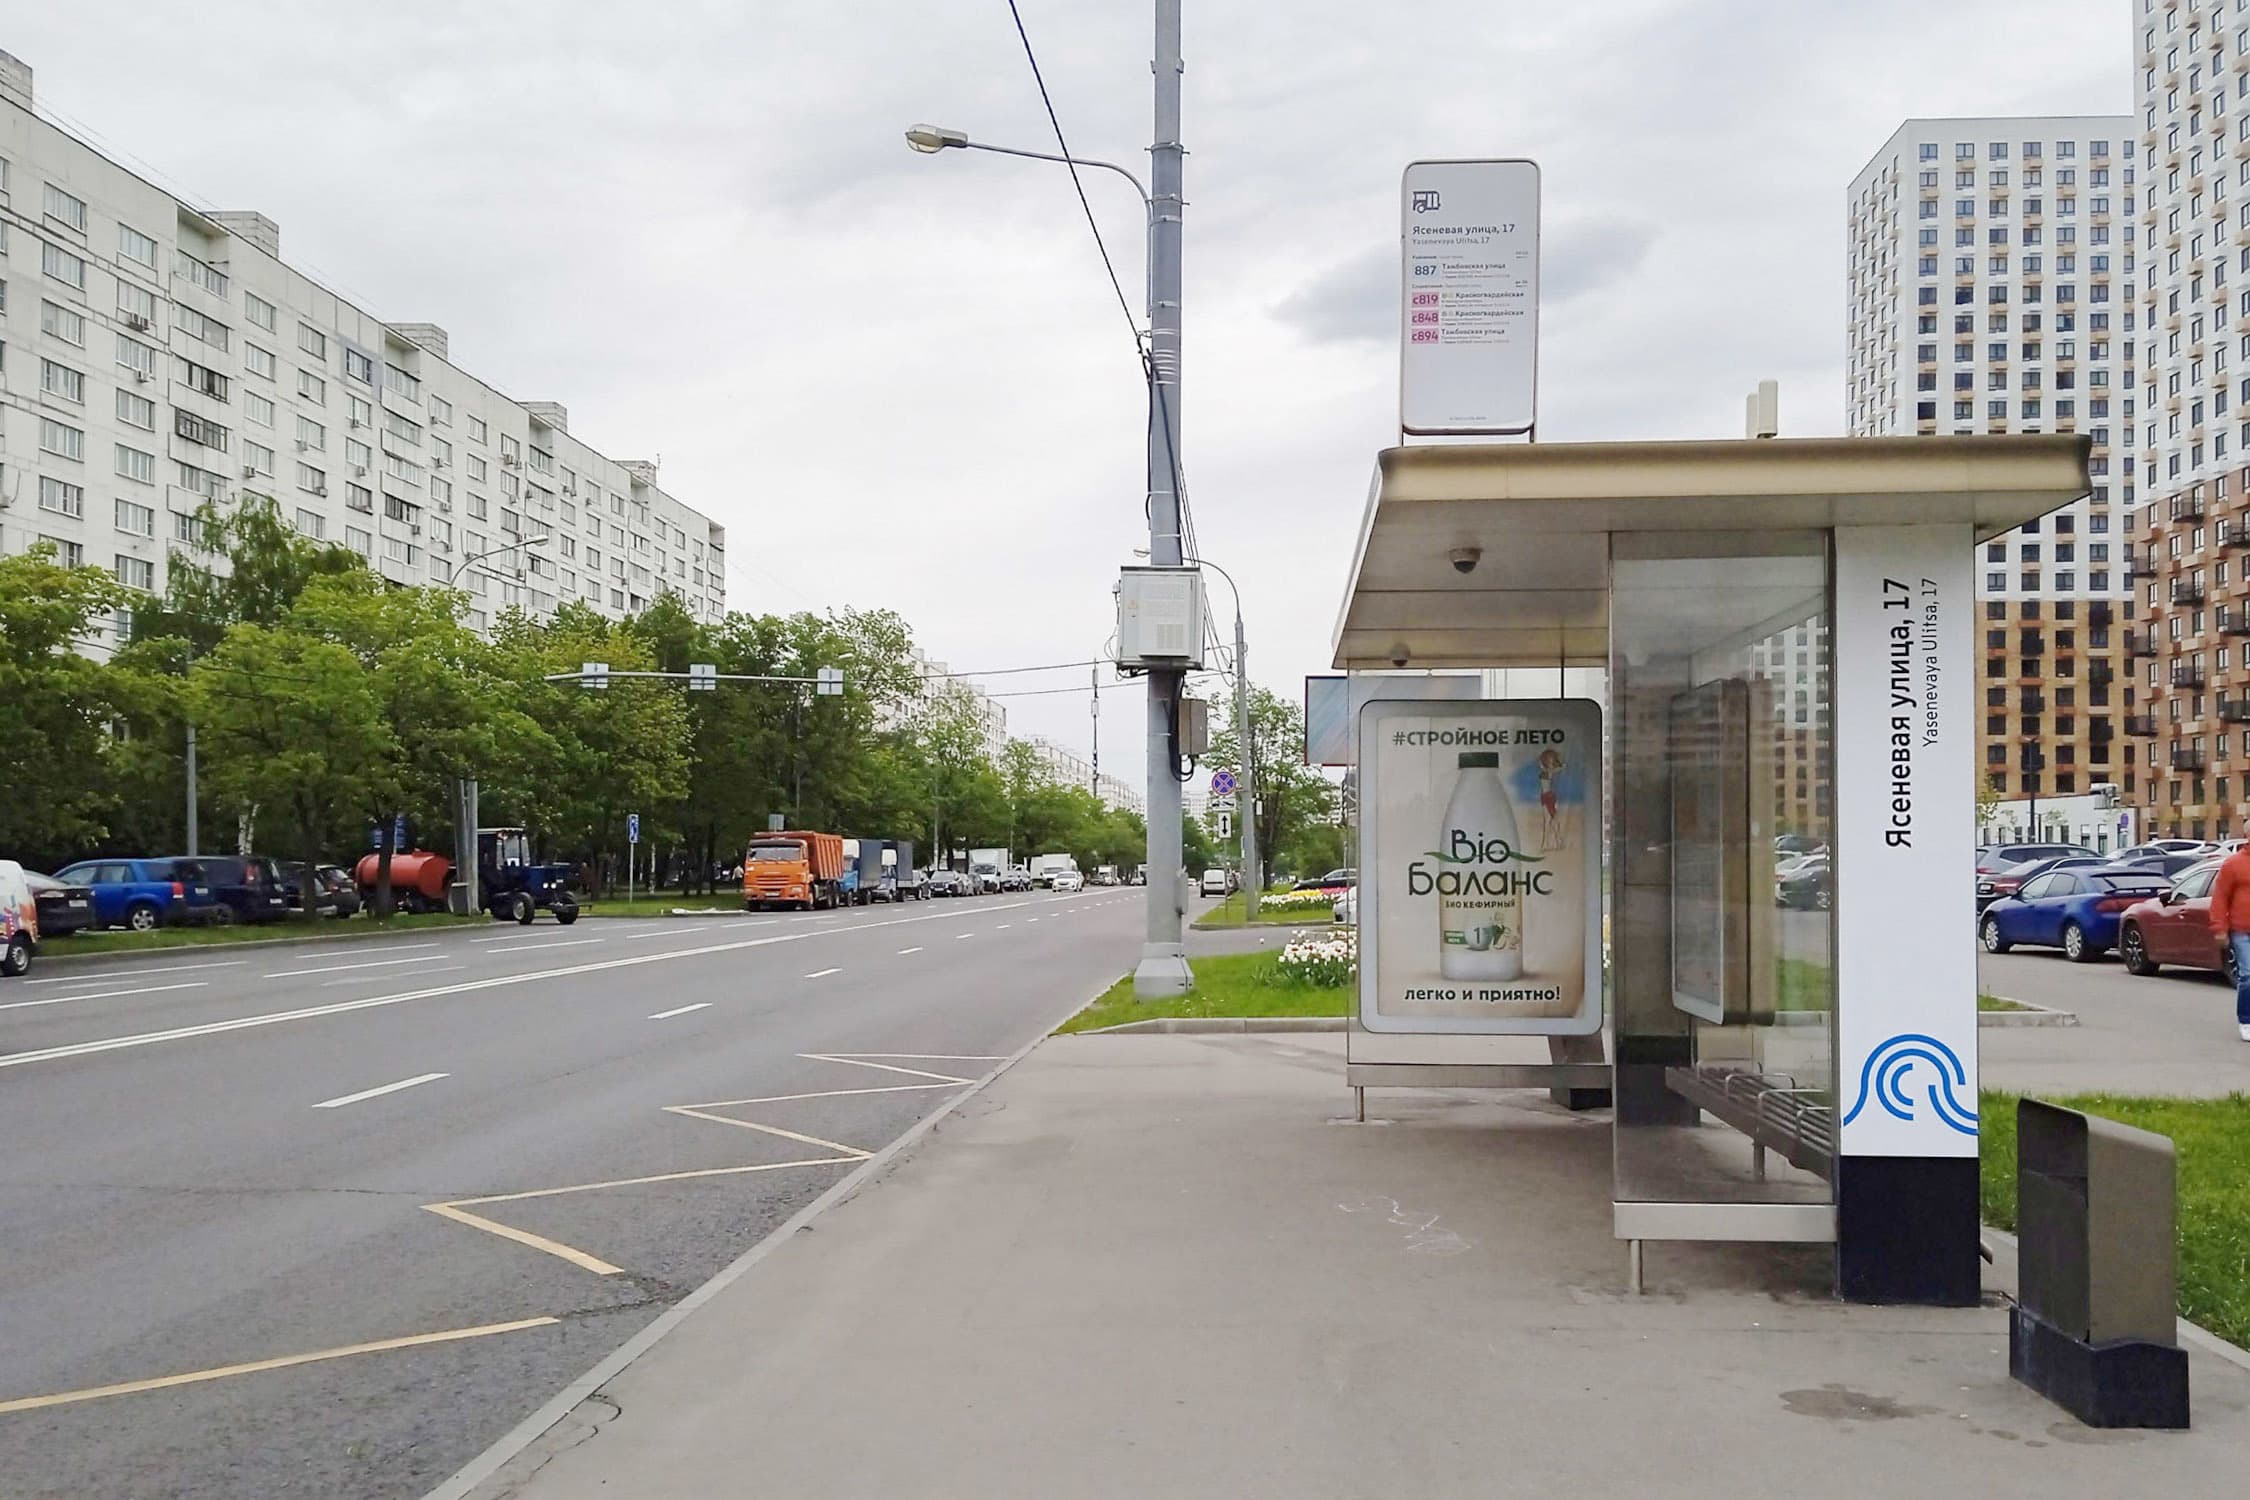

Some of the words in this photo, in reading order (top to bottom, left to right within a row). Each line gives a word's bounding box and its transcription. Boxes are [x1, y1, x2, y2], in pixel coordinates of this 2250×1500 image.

[1412, 226, 1463, 235] Ясеневая
[1465, 225, 1500, 235] улица,
[1502, 224, 1516, 233] 17
[1481, 236, 1490, 244] 17
[1414, 265, 1437, 276] 887
[1412, 294, 1439, 305] с819
[1411, 312, 1439, 323] с848
[1411, 330, 1439, 341] с894
[1883, 578, 1910, 610] 17
[1921, 578, 1937, 597] 17
[1921, 600, 1940, 651] Ulitsa,
[1890, 619, 1917, 708] улица,
[1923, 655, 1941, 747] Yasenevaya
[1392, 727, 1509, 746] #СТРОЙНОЕ
[1513, 728, 1566, 745] ЛЕТО
[1885, 716, 1912, 848] Ясеневая
[1451, 829, 1510, 864] Bio
[1404, 988, 1456, 1001] легко
[1462, 989, 1473, 1001] и
[1478, 985, 1561, 1002] приятно!
